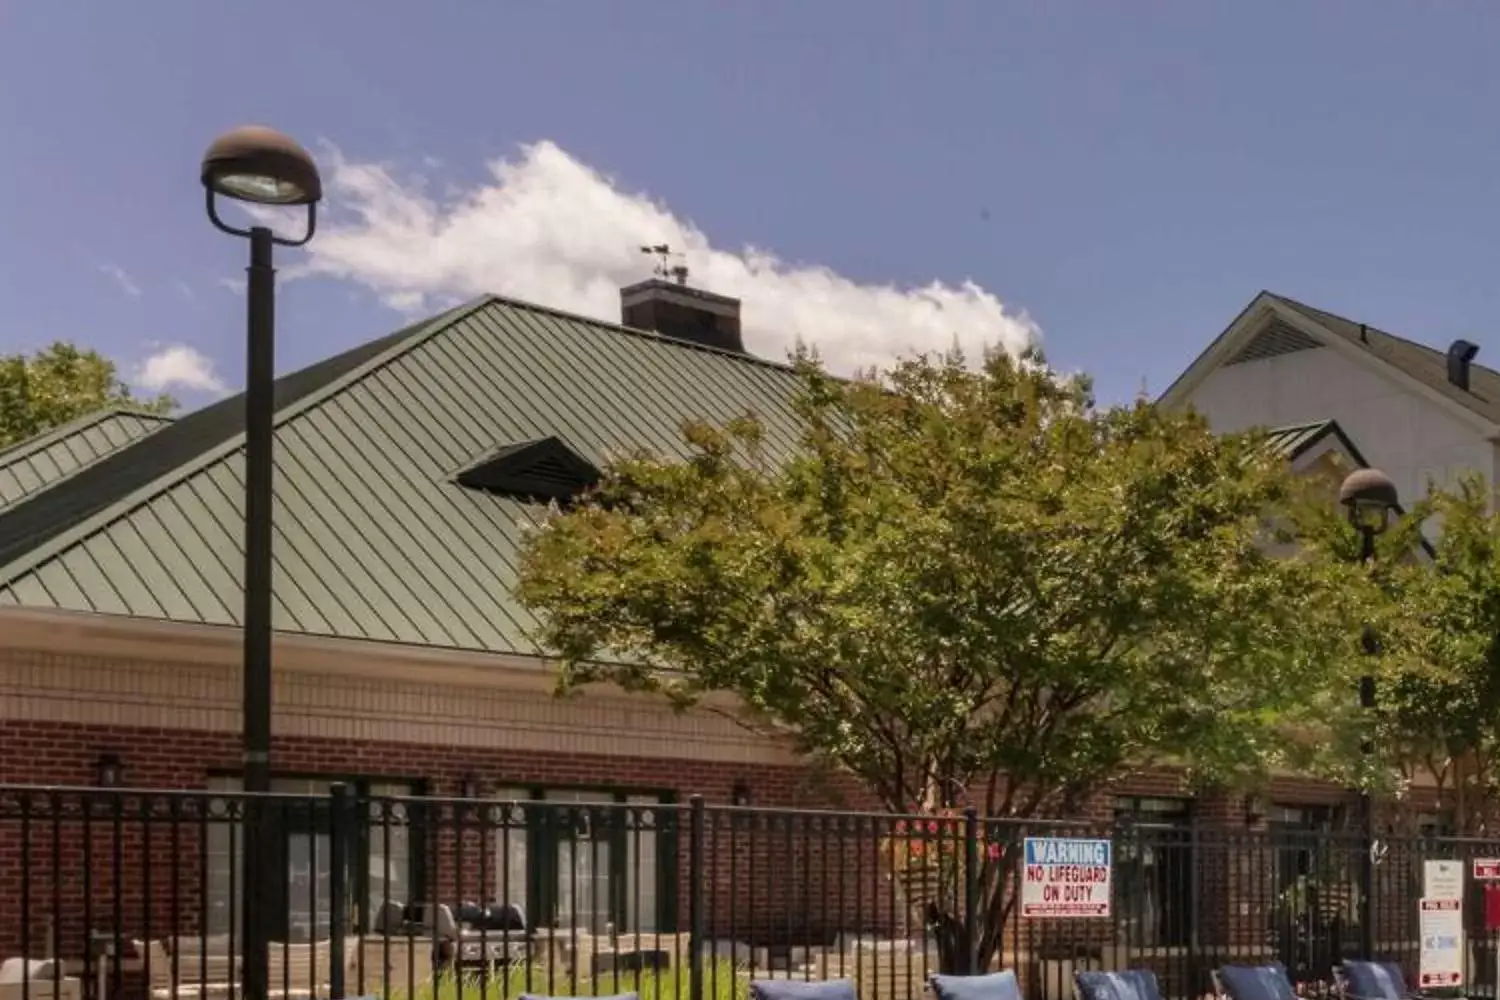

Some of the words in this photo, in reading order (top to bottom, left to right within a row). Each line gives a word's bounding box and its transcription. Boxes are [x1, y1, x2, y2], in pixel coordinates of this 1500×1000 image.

[1032, 840, 1105, 864] WARNING
[1027, 865, 1044, 881] NO
[1049, 866, 1107, 883] LIFEGUARD
[1044, 885, 1059, 901] ON
[1064, 885, 1093, 902] DUTY
